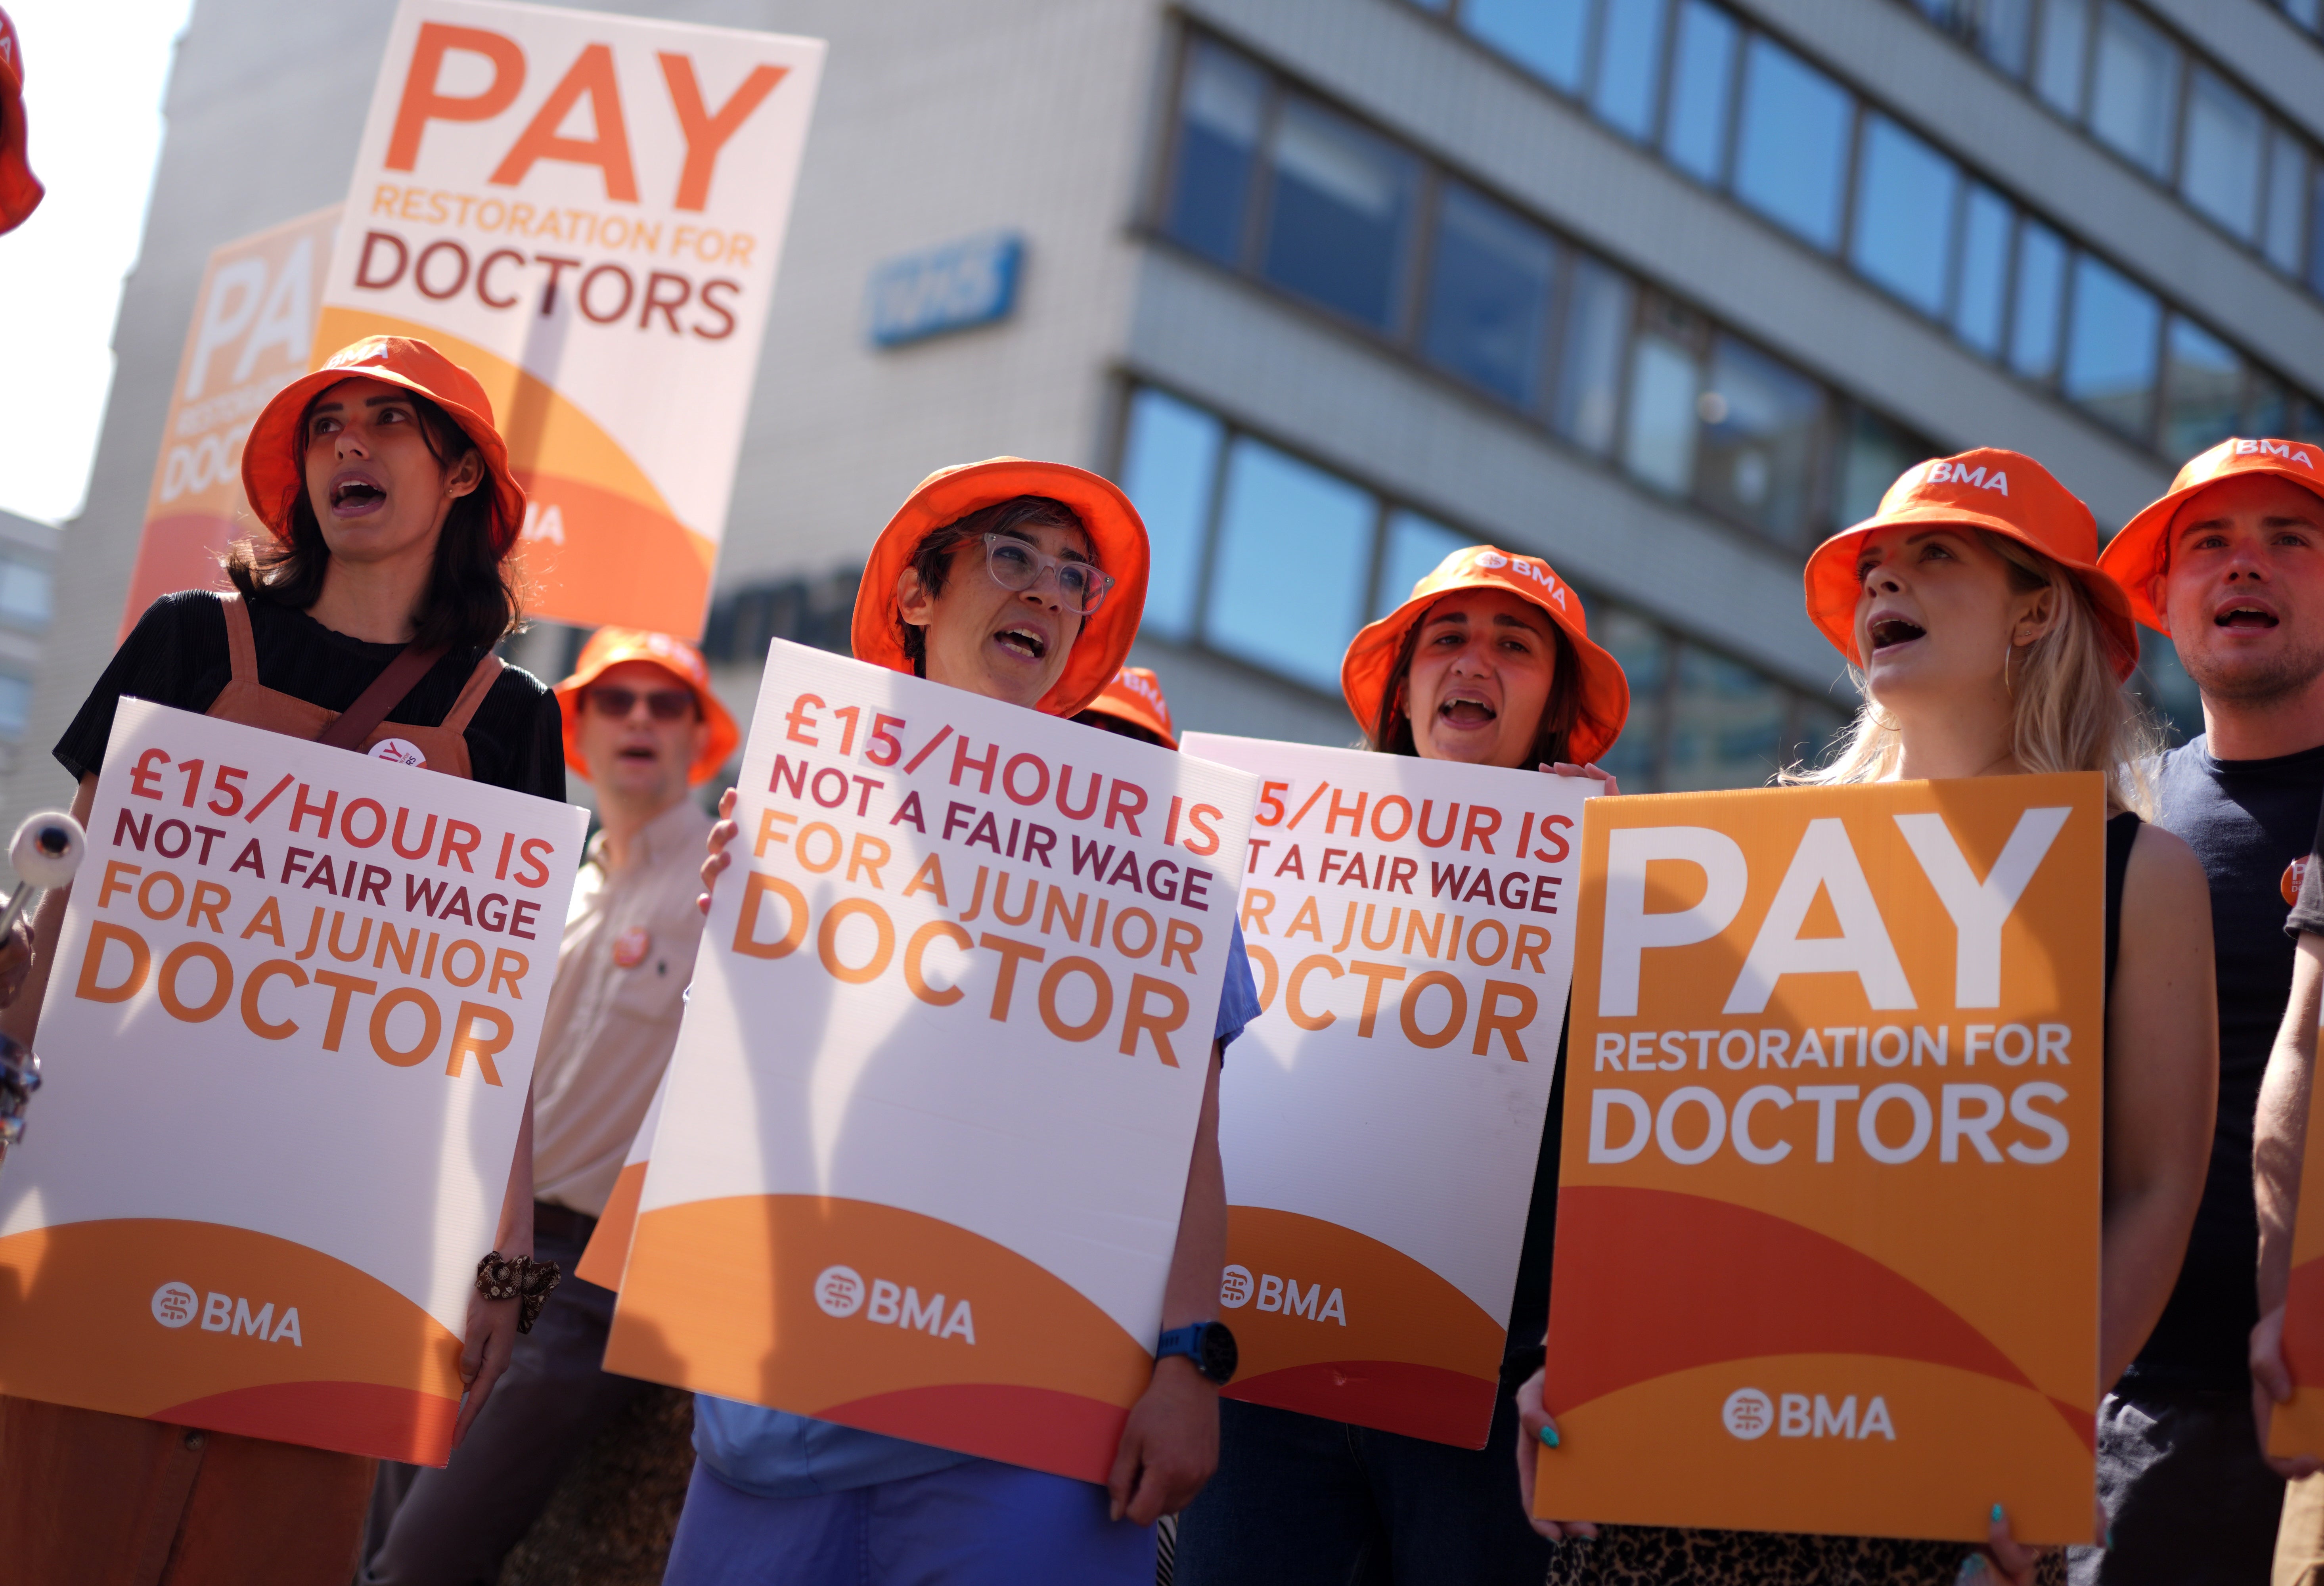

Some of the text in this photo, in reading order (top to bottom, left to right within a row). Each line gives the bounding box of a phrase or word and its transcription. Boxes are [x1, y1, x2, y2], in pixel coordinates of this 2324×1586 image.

[383, 21, 793, 213] PAY
[371, 183, 757, 268] RESTORATION FOR
[185, 236, 313, 400] PA
[353, 229, 744, 341] DOCTORS
[325, 343, 389, 369] BMA
[1926, 462, 2008, 496] BMA
[2236, 439, 2314, 470] BMA
[1512, 558, 1566, 612] BMA
[1123, 671, 1166, 723] BMA
[785, 693, 1224, 856] £15/HOUR IS
[131, 748, 555, 888] £15/HOUR IS
[768, 753, 884, 817] NOT
[890, 790, 927, 834] A
[942, 800, 1058, 869] FAIR
[1072, 835, 1214, 912] WAGE
[1255, 780, 1575, 864] 5/HOUR IS
[112, 808, 542, 940] NOT A FAIR WAGE
[754, 808, 891, 891] FOR
[903, 852, 950, 908] A
[959, 865, 1204, 976] JUNIOR
[1274, 843, 1305, 881] A
[1318, 848, 1418, 895] FAIR
[1431, 861, 1563, 914] WAGE
[1598, 806, 2073, 1017] PAY
[98, 860, 530, 1000] FOR A JUNIOR
[731, 870, 1190, 1069] DOCTOR
[1284, 895, 1323, 942] A
[1332, 900, 1552, 974] JUNIOR
[75, 920, 515, 1087] DOCTOR
[1247, 943, 1539, 1063] CTOR
[1594, 1023, 2073, 1072] RESTORATION FOR
[1588, 1081, 2071, 1165] DOCTORS
[201, 1292, 302, 1347] BMA
[867, 1278, 976, 1345] BMA
[1256, 1274, 1346, 1327] BMA
[1778, 1393, 1897, 1441] BMA
